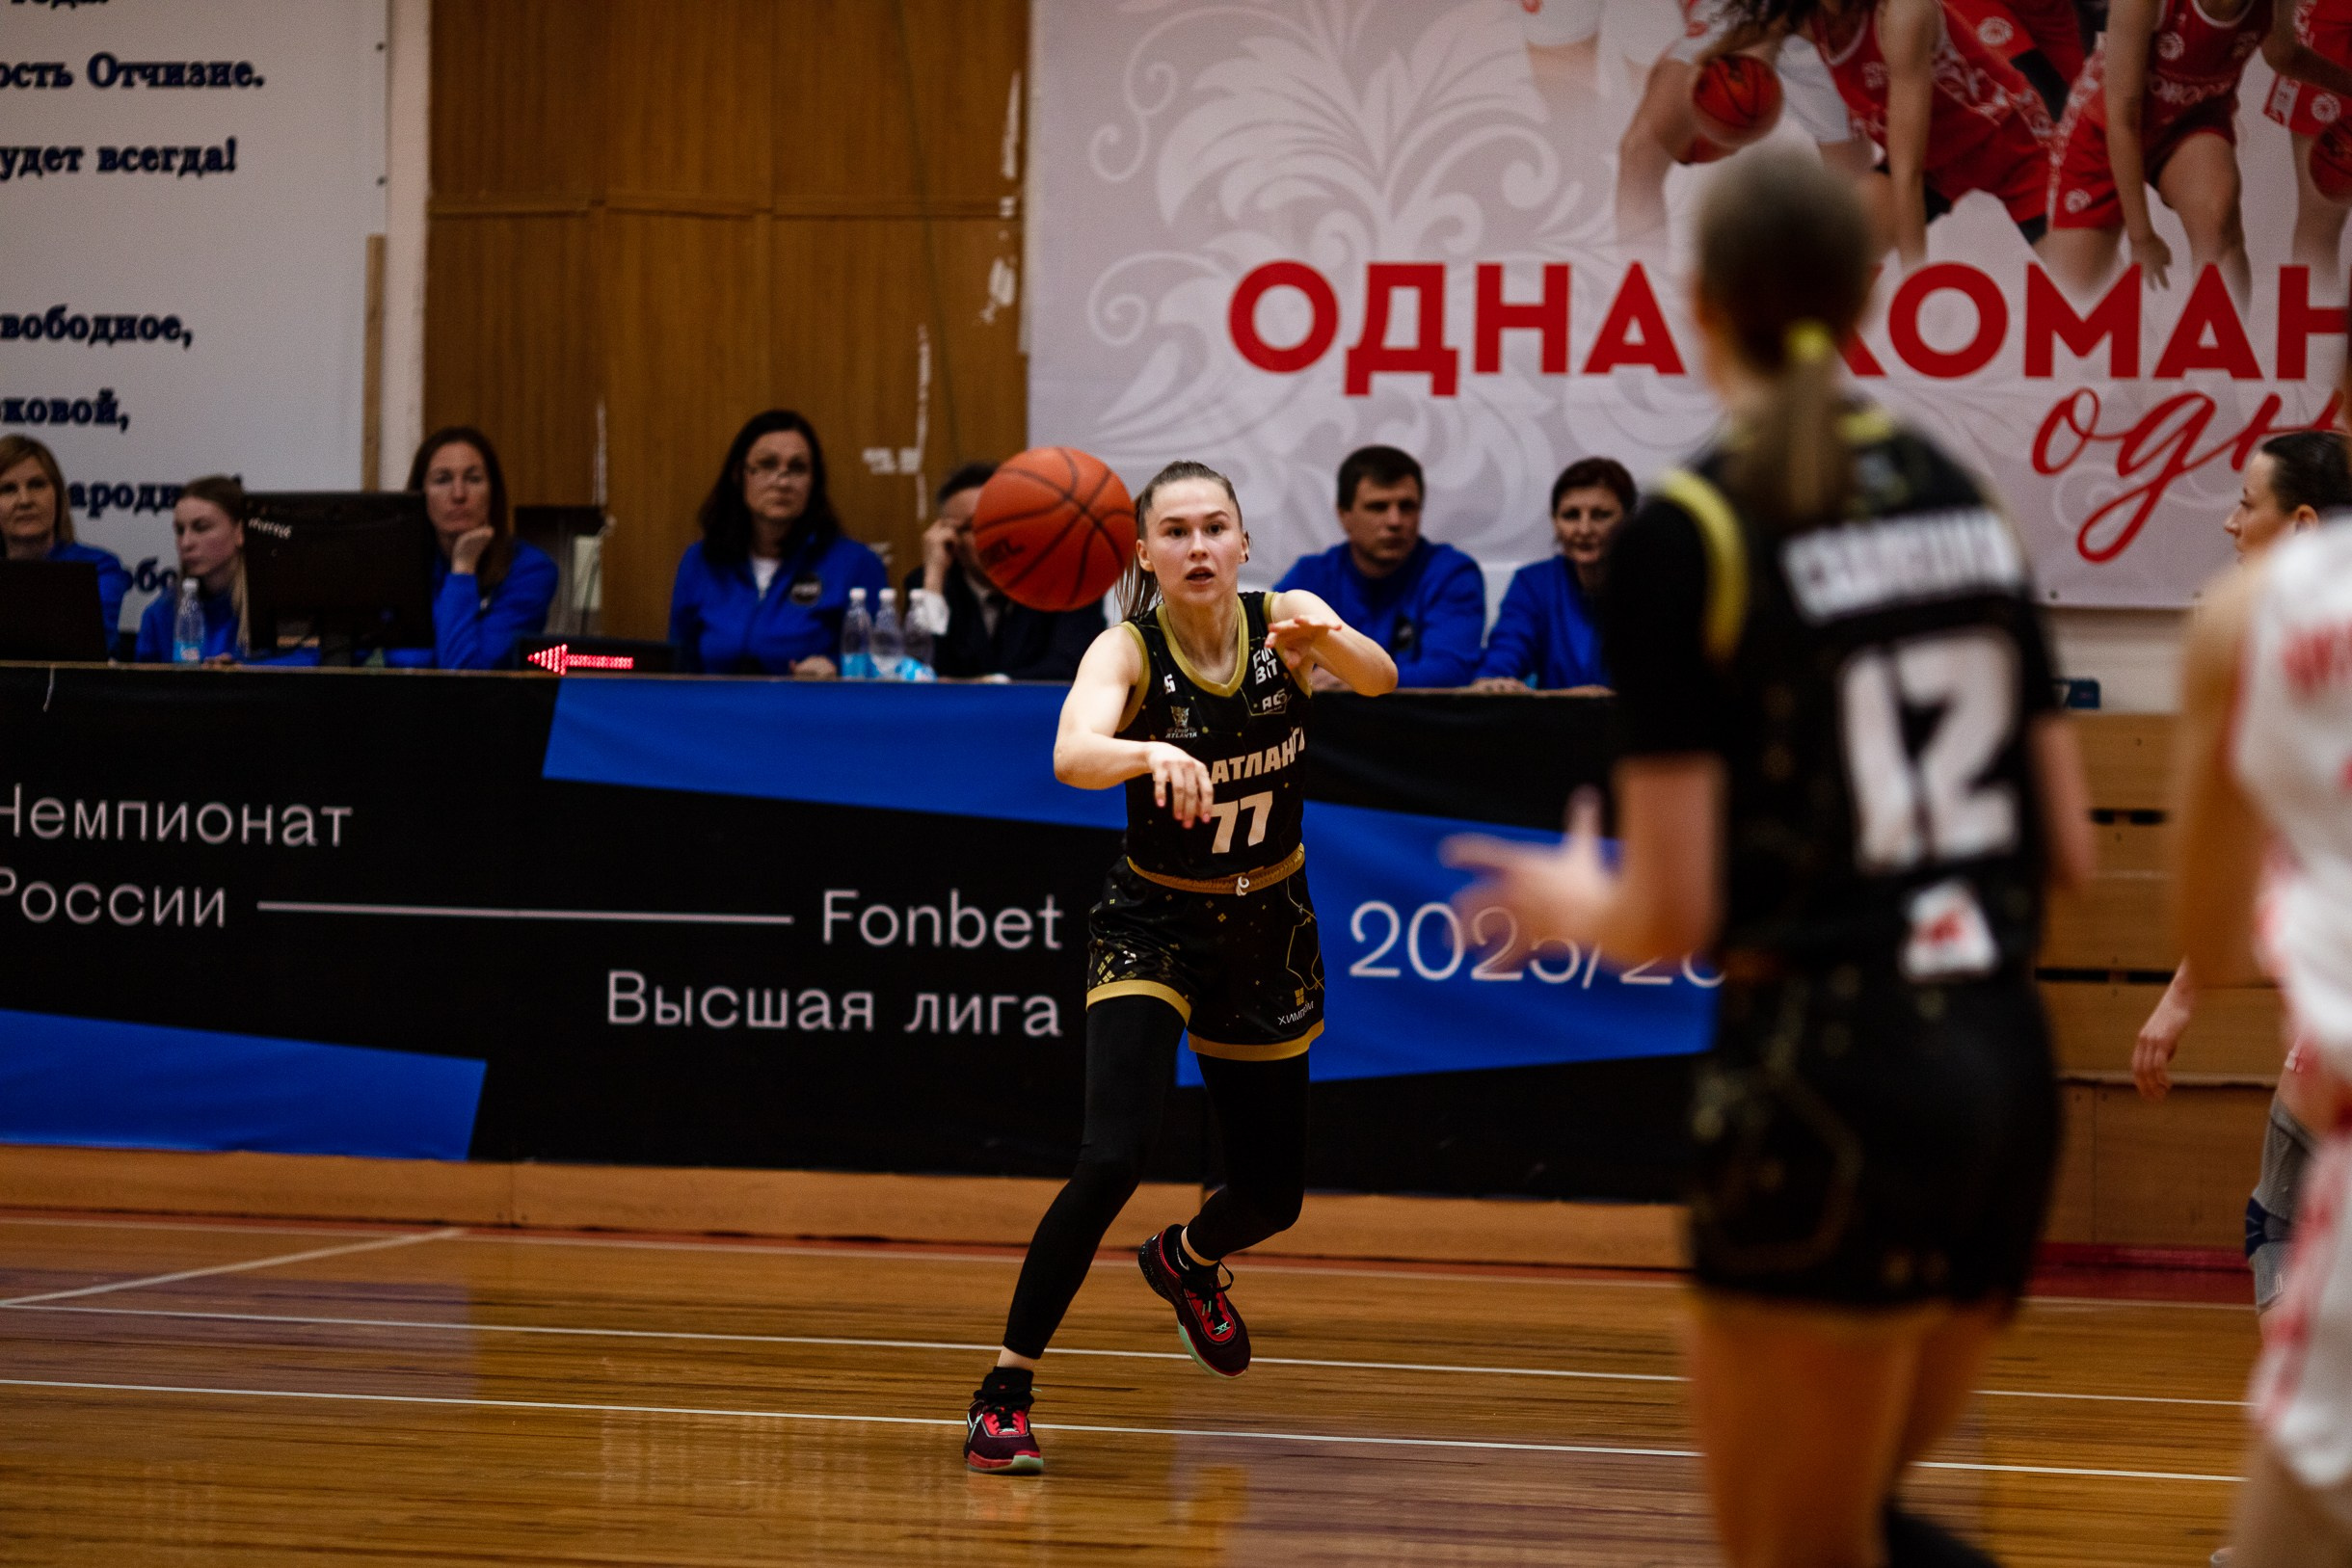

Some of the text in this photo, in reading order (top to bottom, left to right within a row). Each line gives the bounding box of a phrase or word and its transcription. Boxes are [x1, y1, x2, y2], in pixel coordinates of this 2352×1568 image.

[87, 52, 265, 88] Отчизне.
[0, 136, 237, 181] удет всегда!
[0, 304, 193, 348] вободное,
[1228, 259, 1687, 397] ОДНА
[1842, 631, 2019, 865] 12
[1211, 790, 1273, 854] 77
[822, 889, 1063, 949] Fonbet
[607, 970, 1063, 1037] Высшая лига
